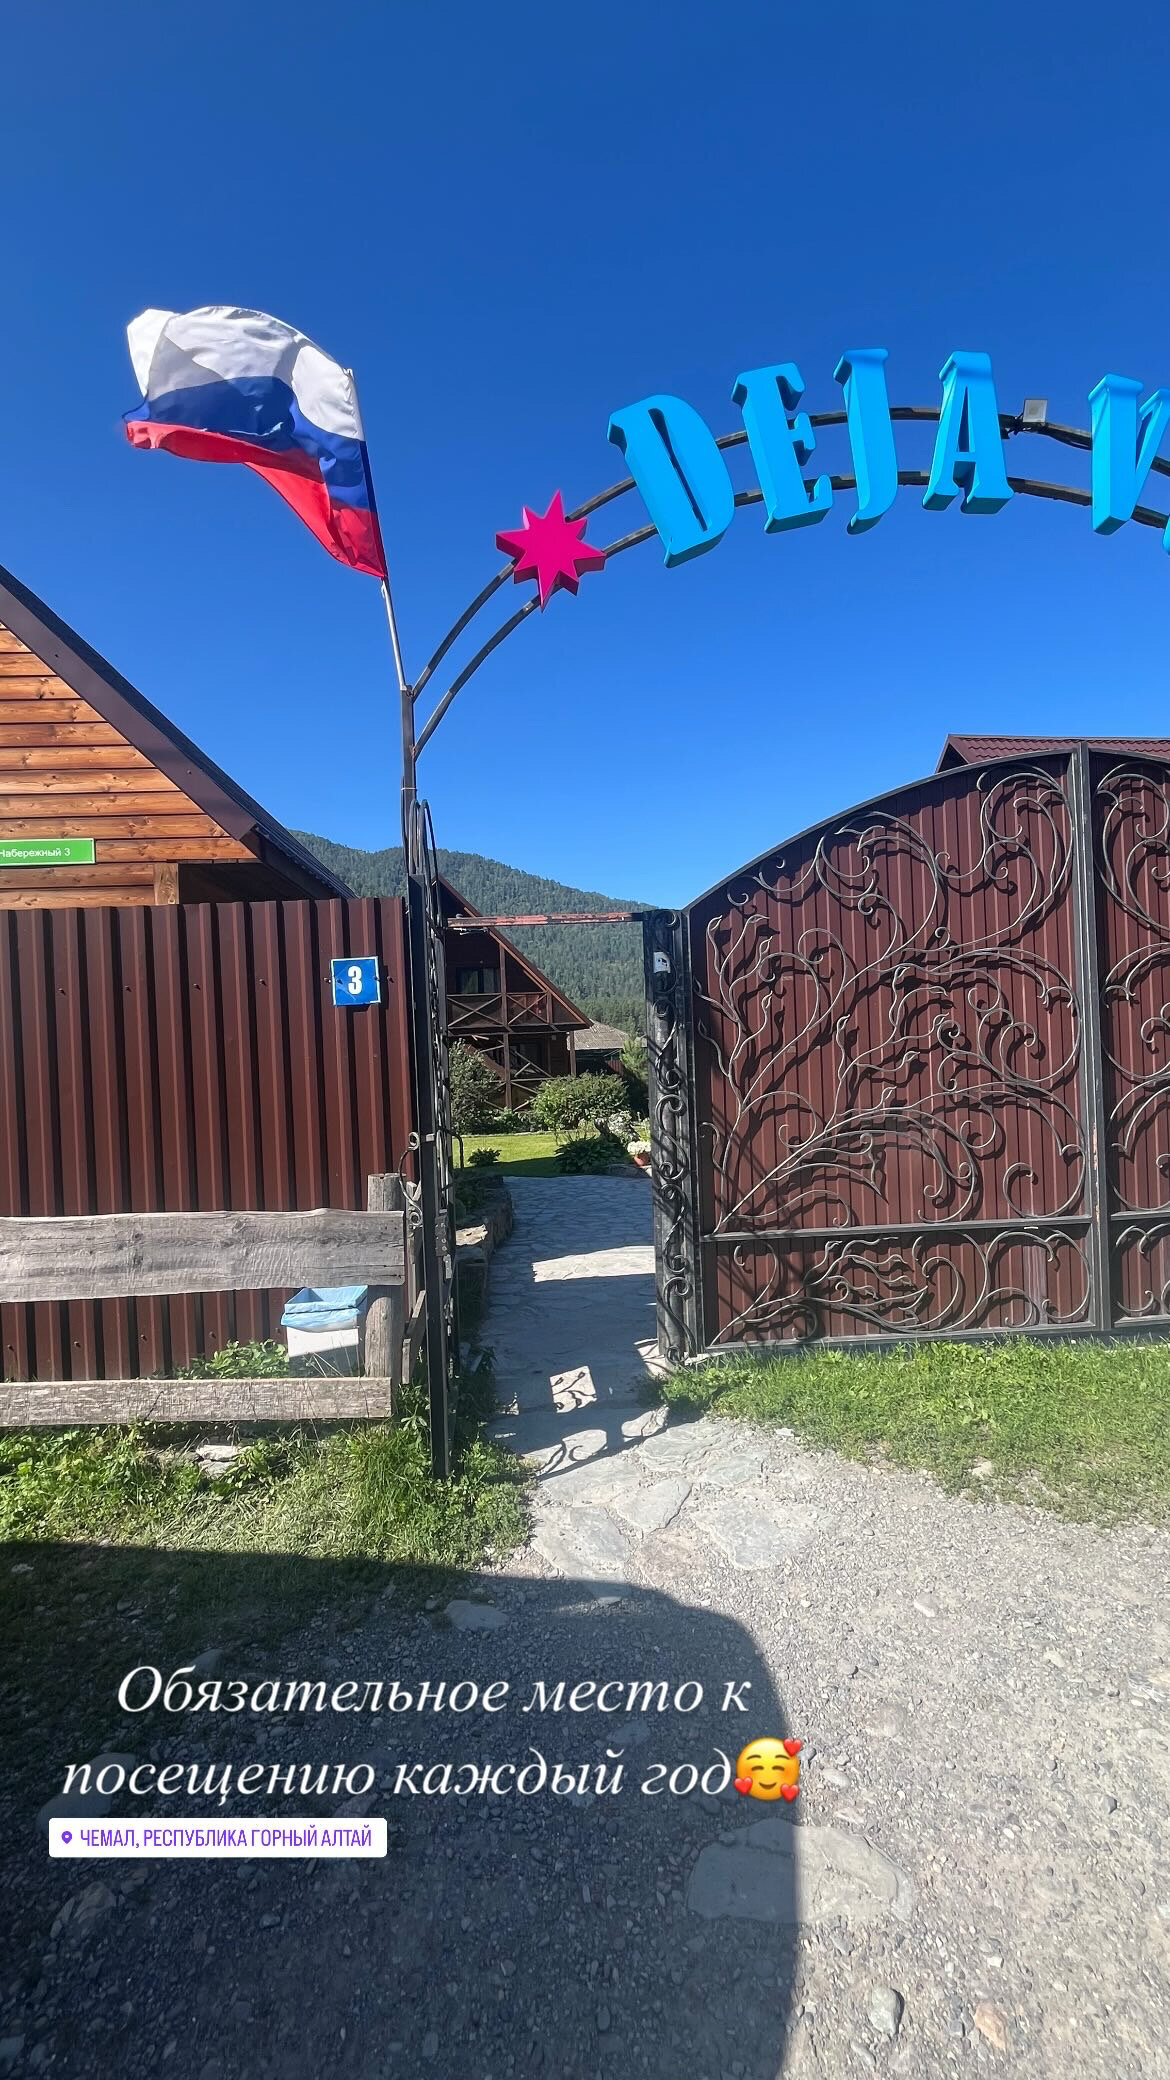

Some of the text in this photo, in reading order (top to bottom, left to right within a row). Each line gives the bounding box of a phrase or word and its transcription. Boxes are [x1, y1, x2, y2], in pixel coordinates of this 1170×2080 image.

[607, 348, 1170, 568] DEJA V
[64, 847, 71, 856] 3
[347, 965, 363, 995] 3
